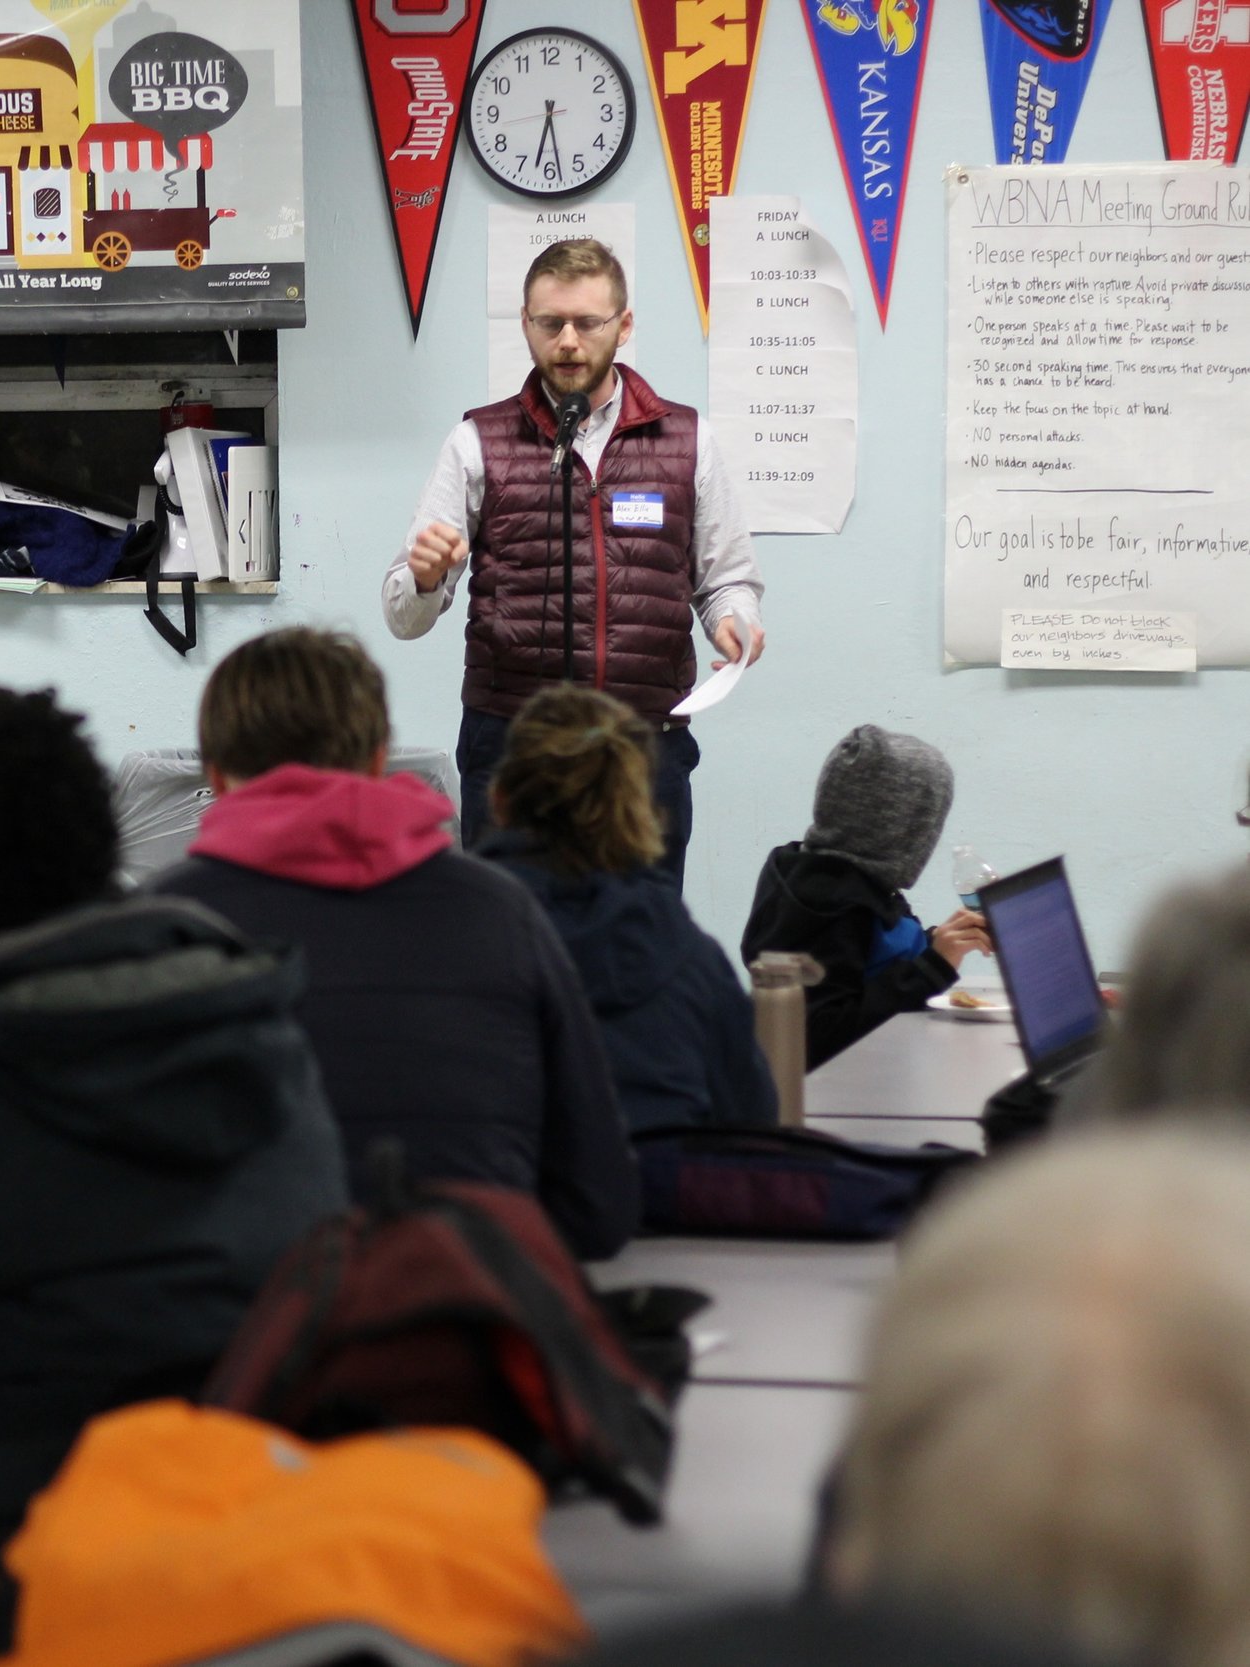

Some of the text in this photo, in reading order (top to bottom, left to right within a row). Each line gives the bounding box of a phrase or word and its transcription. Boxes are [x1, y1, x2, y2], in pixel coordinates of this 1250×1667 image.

[515, 55, 530, 73] 11
[540, 47, 560, 65] 12
[576, 55, 583, 72] 1
[130, 59, 225, 87] BIG TIME
[491, 77, 510, 95] 10
[592, 75, 605, 93] 2
[132, 86, 230, 113] BBQ
[389, 57, 454, 160] OHIO STATE
[487, 105, 500, 124] 9
[601, 104, 613, 122] 3
[858, 61, 892, 200] KANSAS
[495, 134, 507, 152] 8
[592, 133, 605, 150] 4
[515, 156, 528, 172] 7
[572, 154, 584, 172] 5
[690, 102, 702, 209] GOLDEN GOPHERS
[544, 161, 556, 180] 6
[971, 178, 1218, 236] WBNA Meeting Ground
[536, 213, 586, 223] A LUNCH
[757, 211, 799, 222] FRIDAY
[756, 230, 809, 241] A LUNCH
[976, 242, 1213, 268] Please respect our neighbors and our
[18, 274, 56, 288] Year
[61, 274, 102, 290] Long
[228, 270, 270, 280] sodexo
[750, 270, 817, 281] 10:03-10:33
[972, 276, 1209, 296] Listen others with rapture Avoid private
[757, 297, 809, 308] B LUNCH
[985, 292, 1172, 311] while someone else speaking.
[974, 316, 996, 333] One
[999, 321, 1027, 335] person
[1033, 320, 1070, 335] speaks
[1074, 318, 1088, 333] at
[1136, 316, 1169, 332] Please
[1172, 320, 1197, 332] wait
[1216, 318, 1229, 332] be
[749, 336, 815, 347] 10:35-11:05
[980, 335, 1034, 350] recognized
[1040, 334, 1059, 346] and
[1067, 333, 1094, 346] allow
[1098, 334, 1123, 346] time
[1129, 333, 1143, 346] for
[756, 365, 808, 375] C LUNCH
[973, 360, 990, 373] 30
[994, 360, 1032, 373] second
[1037, 361, 1082, 379] speaking
[1116, 360, 1136, 373] This
[1141, 362, 1176, 375] ensures
[1181, 363, 1203, 373] that
[976, 375, 994, 386] has
[1013, 376, 1044, 386] chance
[1066, 375, 1079, 387] be
[749, 404, 815, 415] 11:07-11:37
[973, 401, 997, 417] Keep
[1004, 402, 1021, 414] the
[1024, 402, 1049, 415] focus
[1052, 405, 1068, 416] on
[1071, 403, 1089, 415] the
[1094, 403, 1119, 418] topic
[1126, 403, 1140, 415] at
[754, 432, 808, 442] D LUNCH
[973, 427, 992, 442] NO
[1000, 430, 1043, 446] personal
[971, 454, 988, 468] NO
[995, 455, 1027, 469] hidden
[748, 471, 814, 482] 11:39-12:09
[955, 515, 992, 549] Our
[999, 514, 1035, 561] goal
[1041, 530, 1054, 549] is
[1023, 567, 1049, 589] and
[1011, 614, 1171, 627] PLEASE Do not block
[1011, 633, 1031, 642] our
[1039, 630, 1105, 644] neighbors
[1012, 650, 1042, 658] even
[1053, 648, 1070, 661] by
